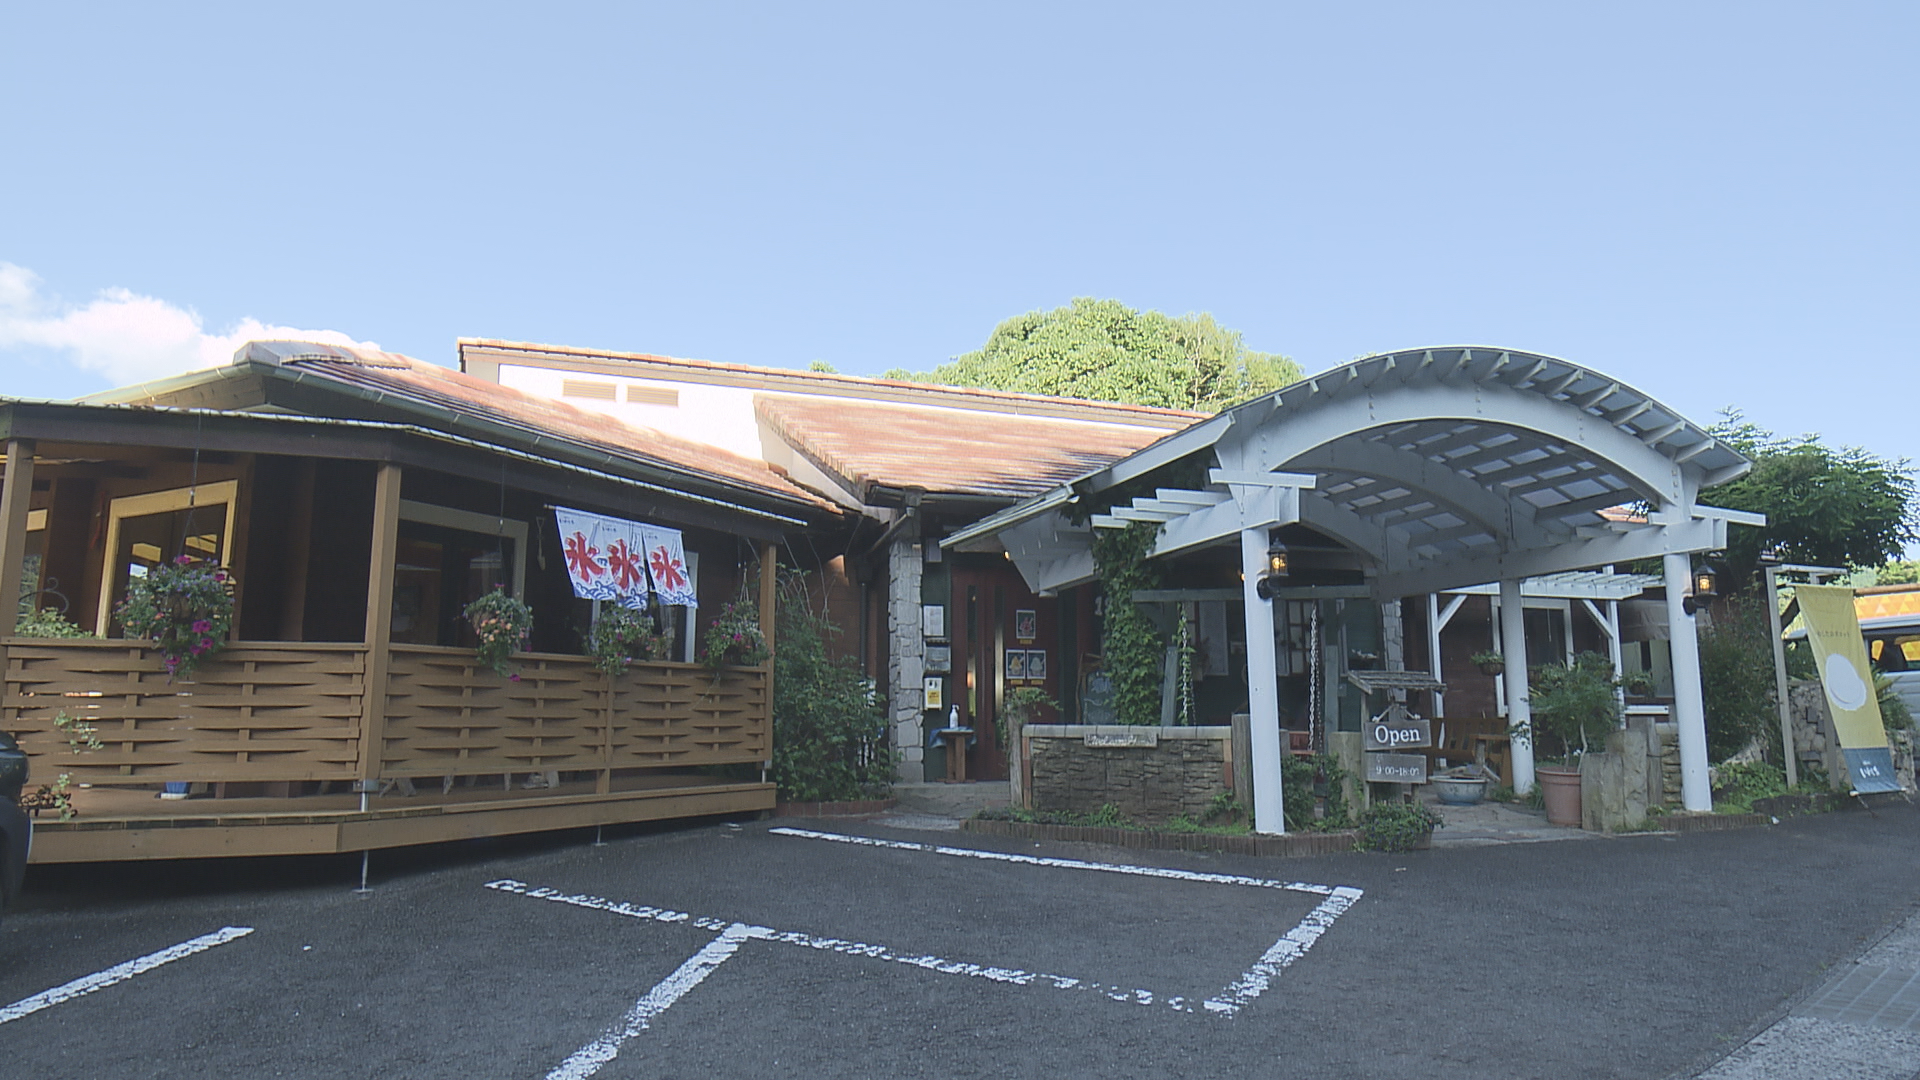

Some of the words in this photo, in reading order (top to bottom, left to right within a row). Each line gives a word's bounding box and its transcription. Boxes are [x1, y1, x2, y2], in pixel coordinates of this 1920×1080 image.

[565, 531, 607, 585] 氷
[607, 538, 641, 592] 氷
[651, 545, 686, 592] 氷
[1375, 725, 1421, 746] Open
